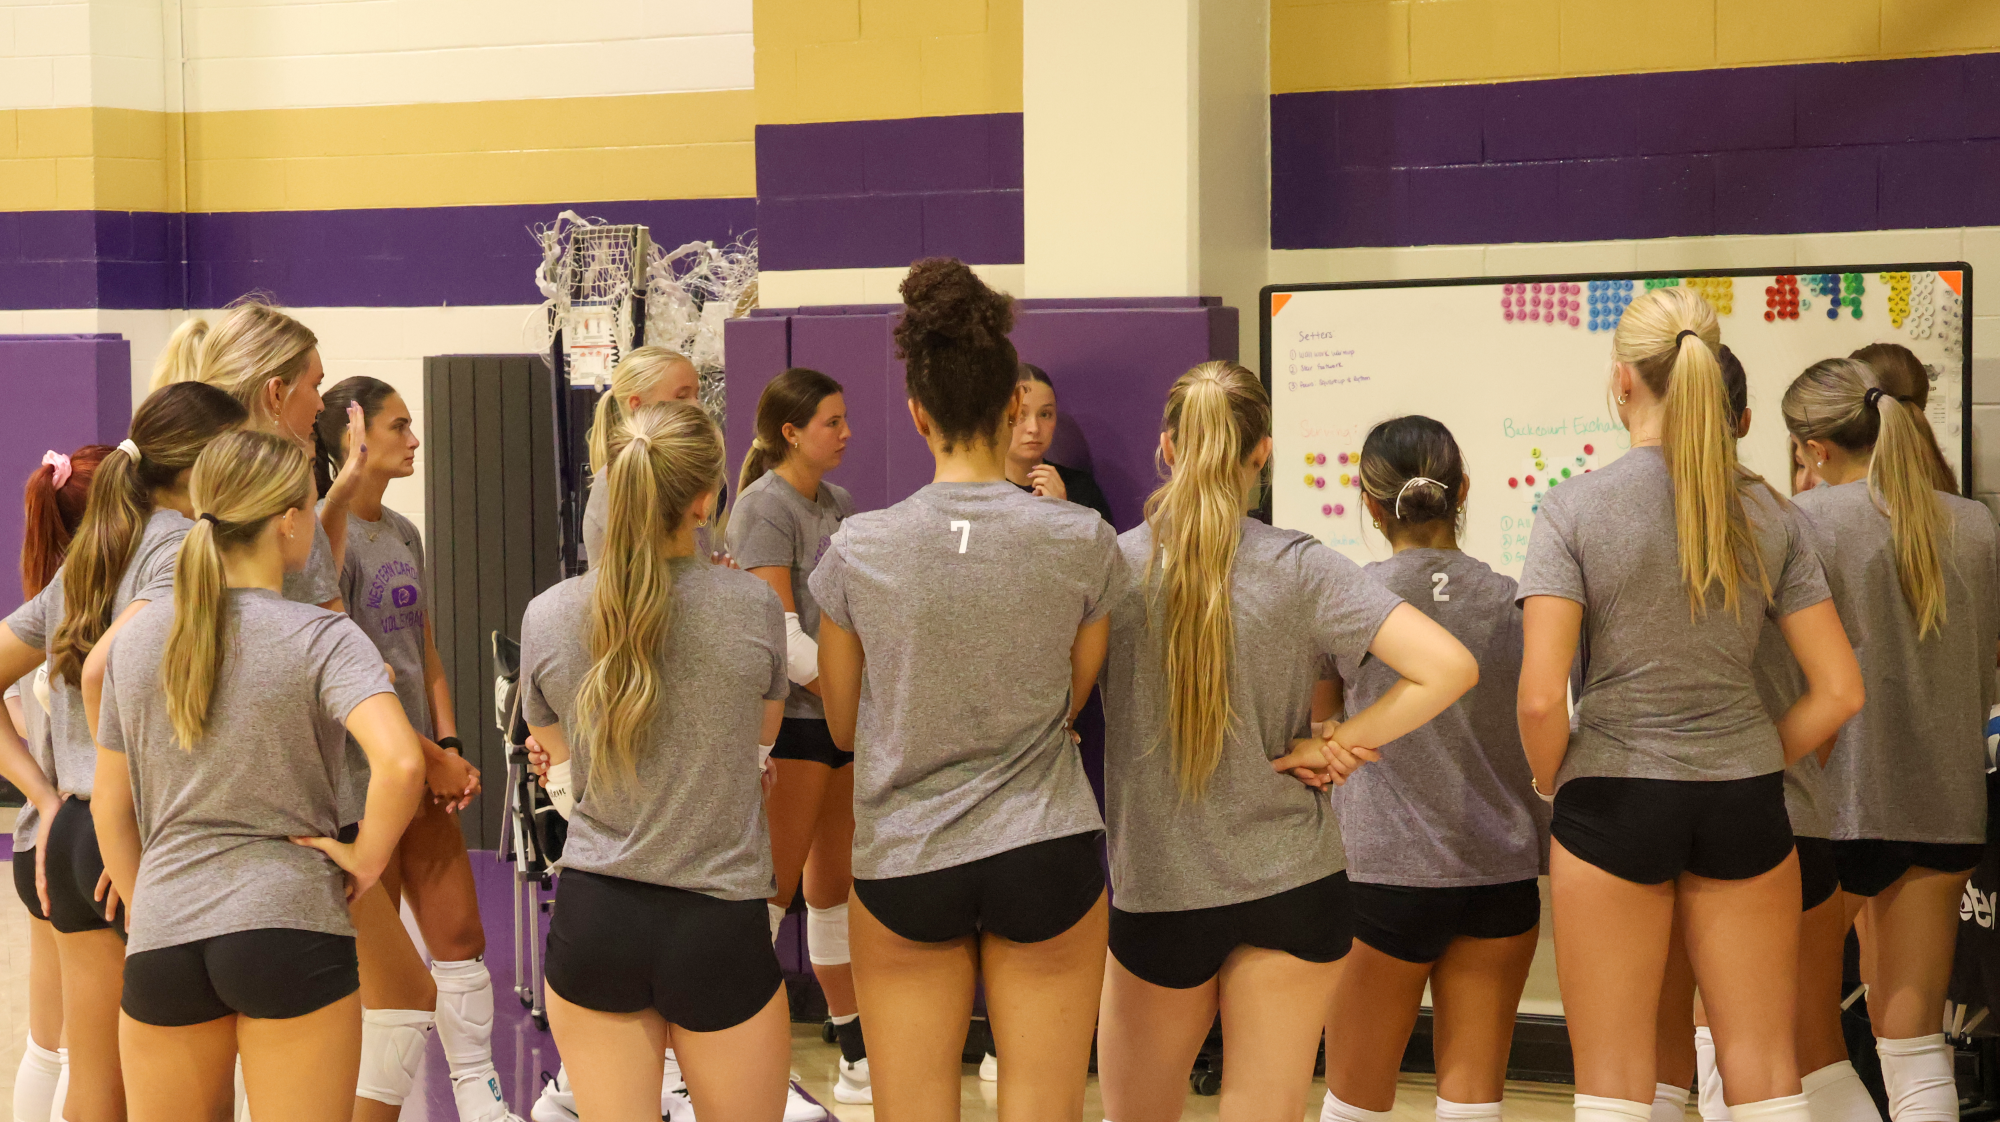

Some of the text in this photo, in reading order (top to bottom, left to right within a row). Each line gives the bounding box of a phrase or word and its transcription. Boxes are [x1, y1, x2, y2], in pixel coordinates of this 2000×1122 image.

[1503, 417, 1567, 438] Backcourt
[950, 520, 971, 554] 7
[366, 562, 396, 609] WESTERN
[1431, 572, 1450, 602] 2
